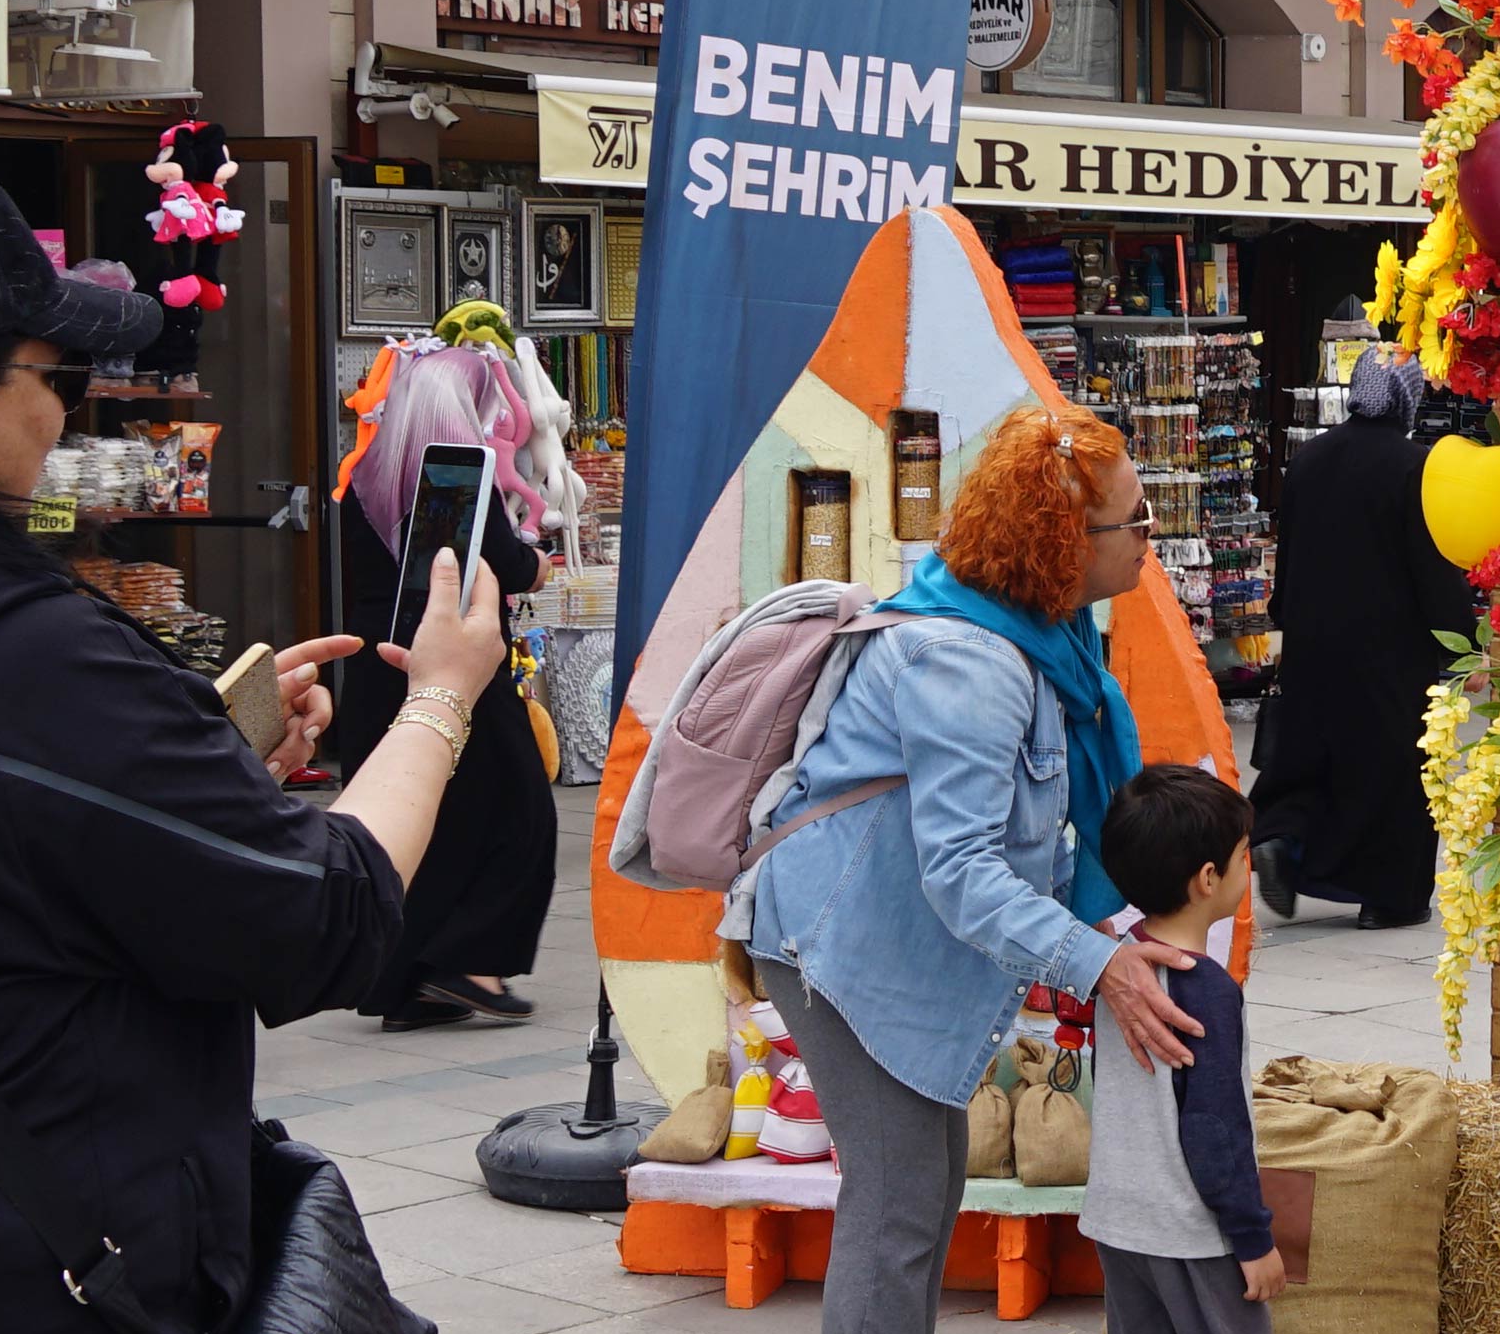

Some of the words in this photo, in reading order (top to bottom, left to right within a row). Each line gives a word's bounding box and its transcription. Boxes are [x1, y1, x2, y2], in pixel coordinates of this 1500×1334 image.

[693, 34, 956, 144] BENİM
[683, 137, 947, 224] ŞEHRİM
[1059, 142, 1426, 209] HEDİYEL
